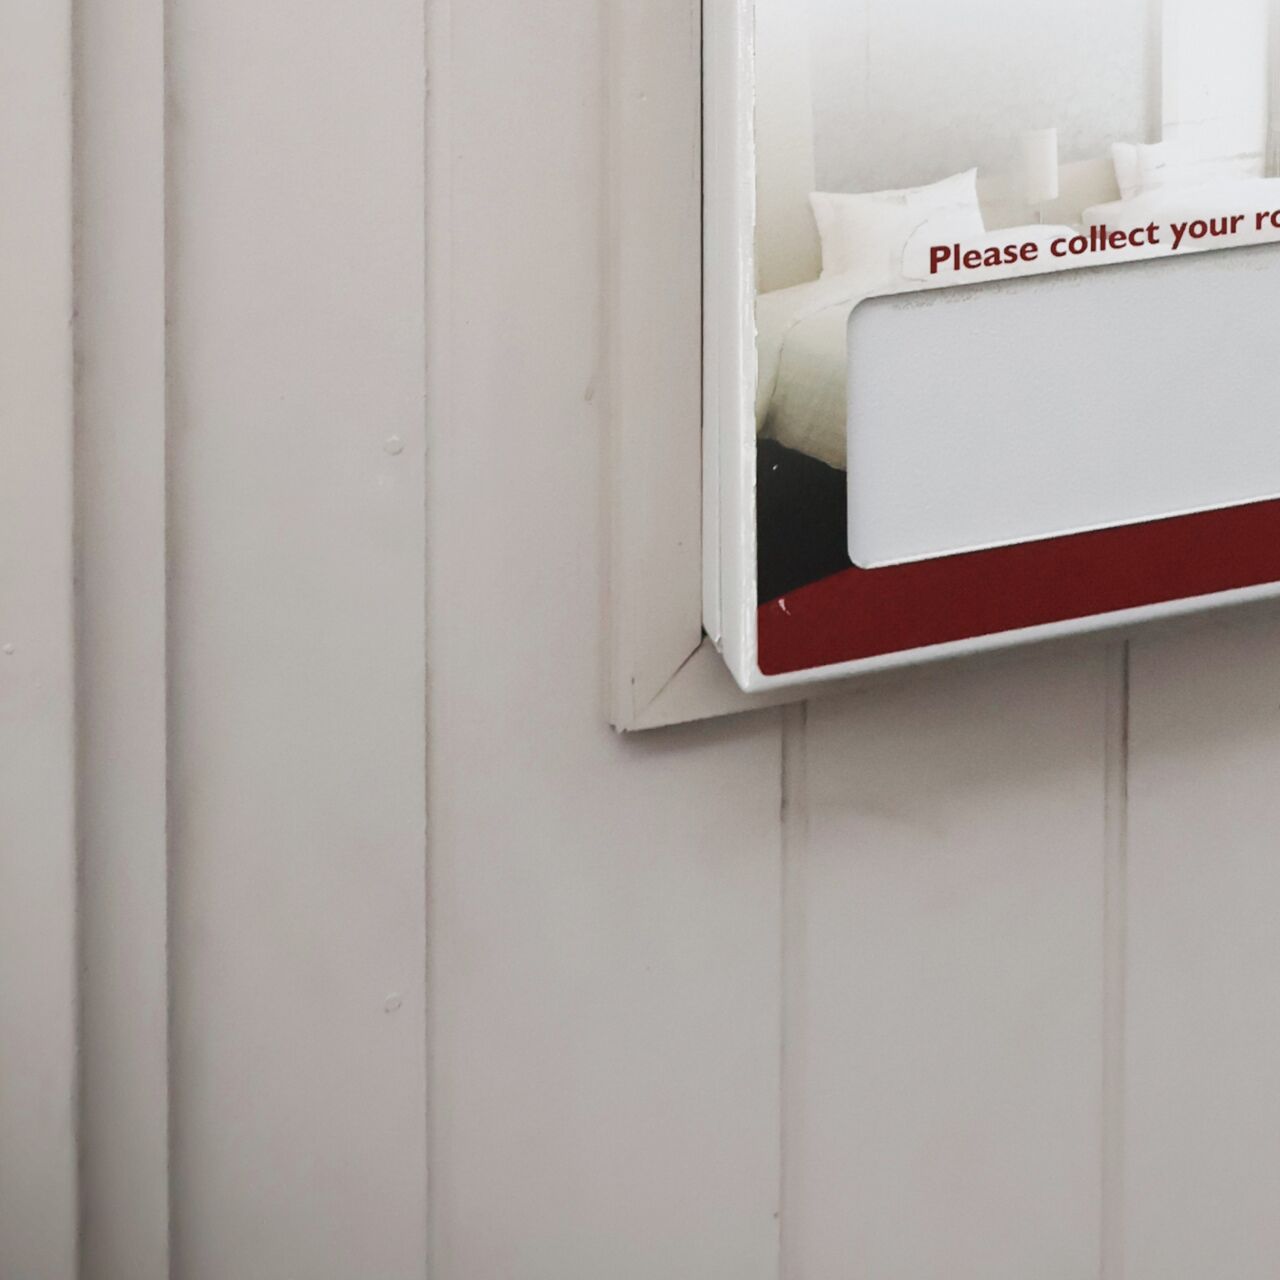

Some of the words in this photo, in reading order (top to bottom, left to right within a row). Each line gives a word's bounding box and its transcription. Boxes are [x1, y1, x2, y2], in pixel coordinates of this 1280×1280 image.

[929, 243, 1039, 275] Please
[1050, 222, 1160, 258] collect
[1169, 214, 1245, 250] your
